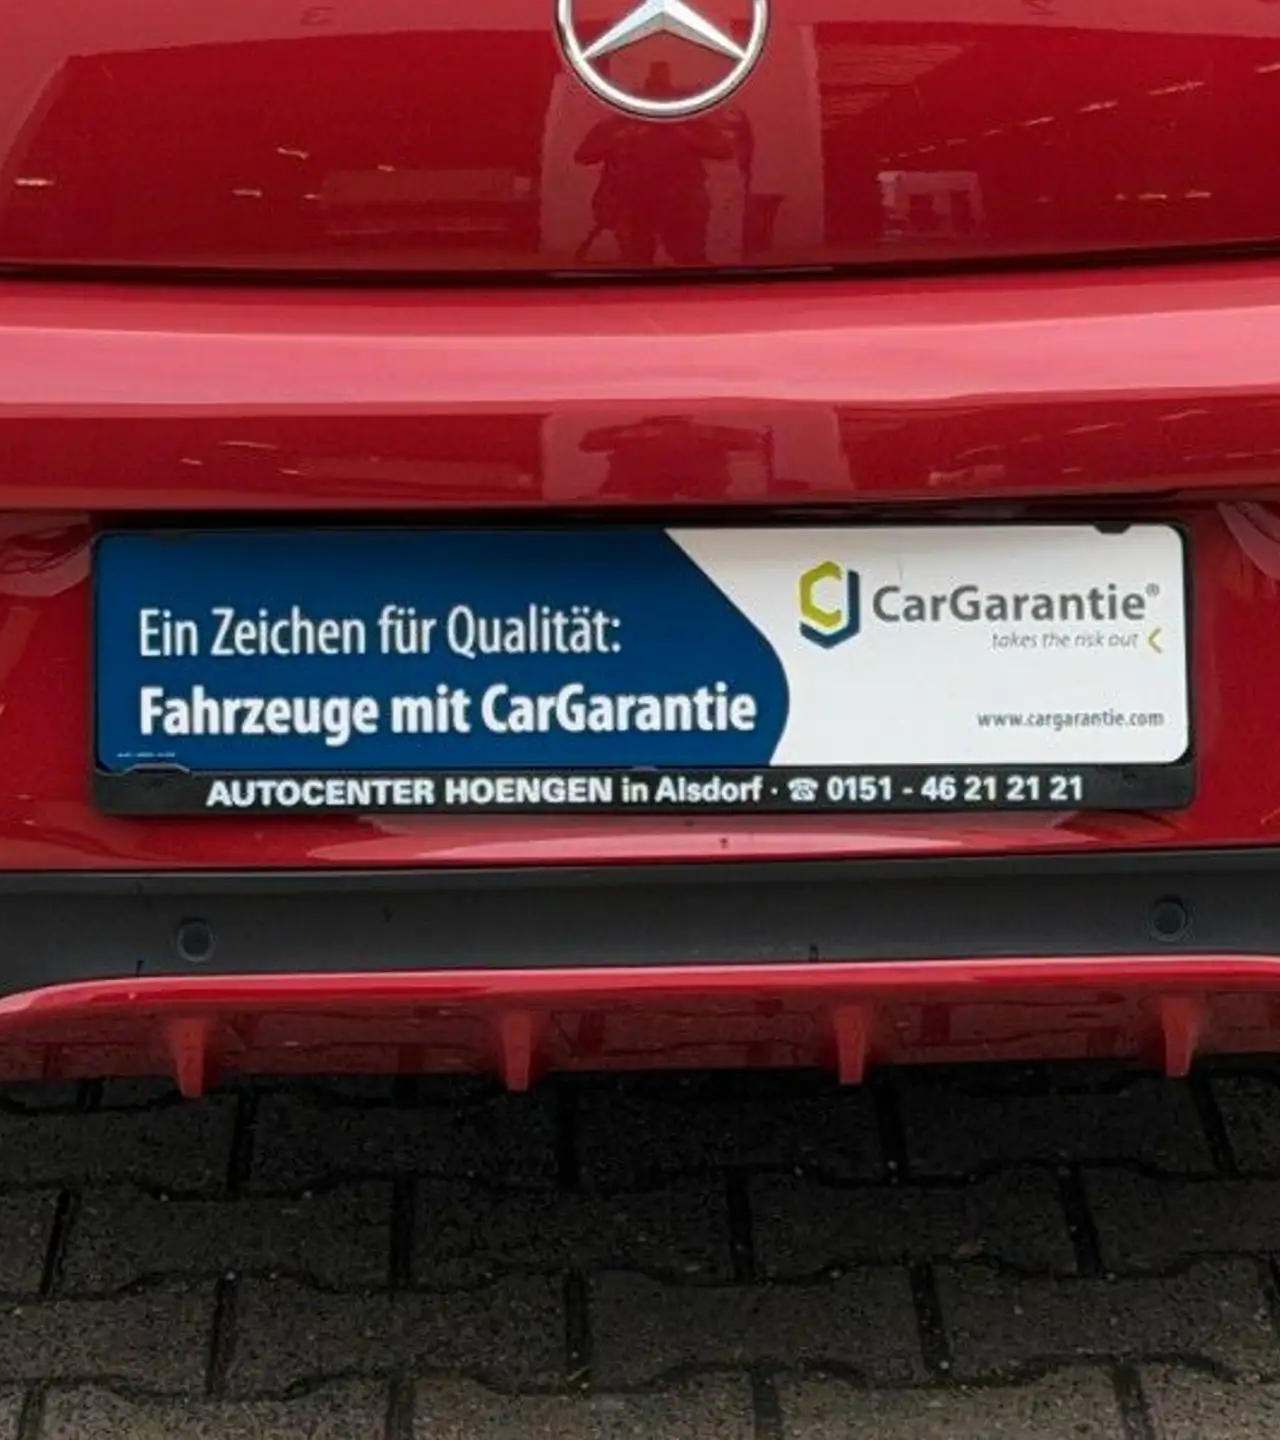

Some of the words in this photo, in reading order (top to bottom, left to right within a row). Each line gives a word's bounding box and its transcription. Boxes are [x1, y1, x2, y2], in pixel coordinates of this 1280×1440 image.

[140, 608, 198, 657] Ein
[210, 605, 366, 656] Zeichen
[377, 604, 436, 655] für
[446, 603, 621, 659] Qualität:
[992, 631, 1037, 649] takes
[1043, 631, 1070, 648] the
[1074, 630, 1104, 648] risk
[1108, 633, 1139, 649] out
[140, 684, 379, 747] Fahrzeuge
[390, 684, 471, 734] mit
[481, 681, 757, 733] CarGarantie
[977, 709, 1164, 731] www.cargarantie.com
[205, 777, 435, 807] AUTOCENTER
[445, 776, 613, 805] HOENGEN
[621, 776, 649, 802] in
[654, 775, 763, 802] Alsdorf
[826, 775, 892, 801] 0151
[920, 775, 957, 801] 46
[963, 774, 997, 801] 21
[1006, 774, 1040, 801] 21
[1049, 774, 1083, 801] 21
